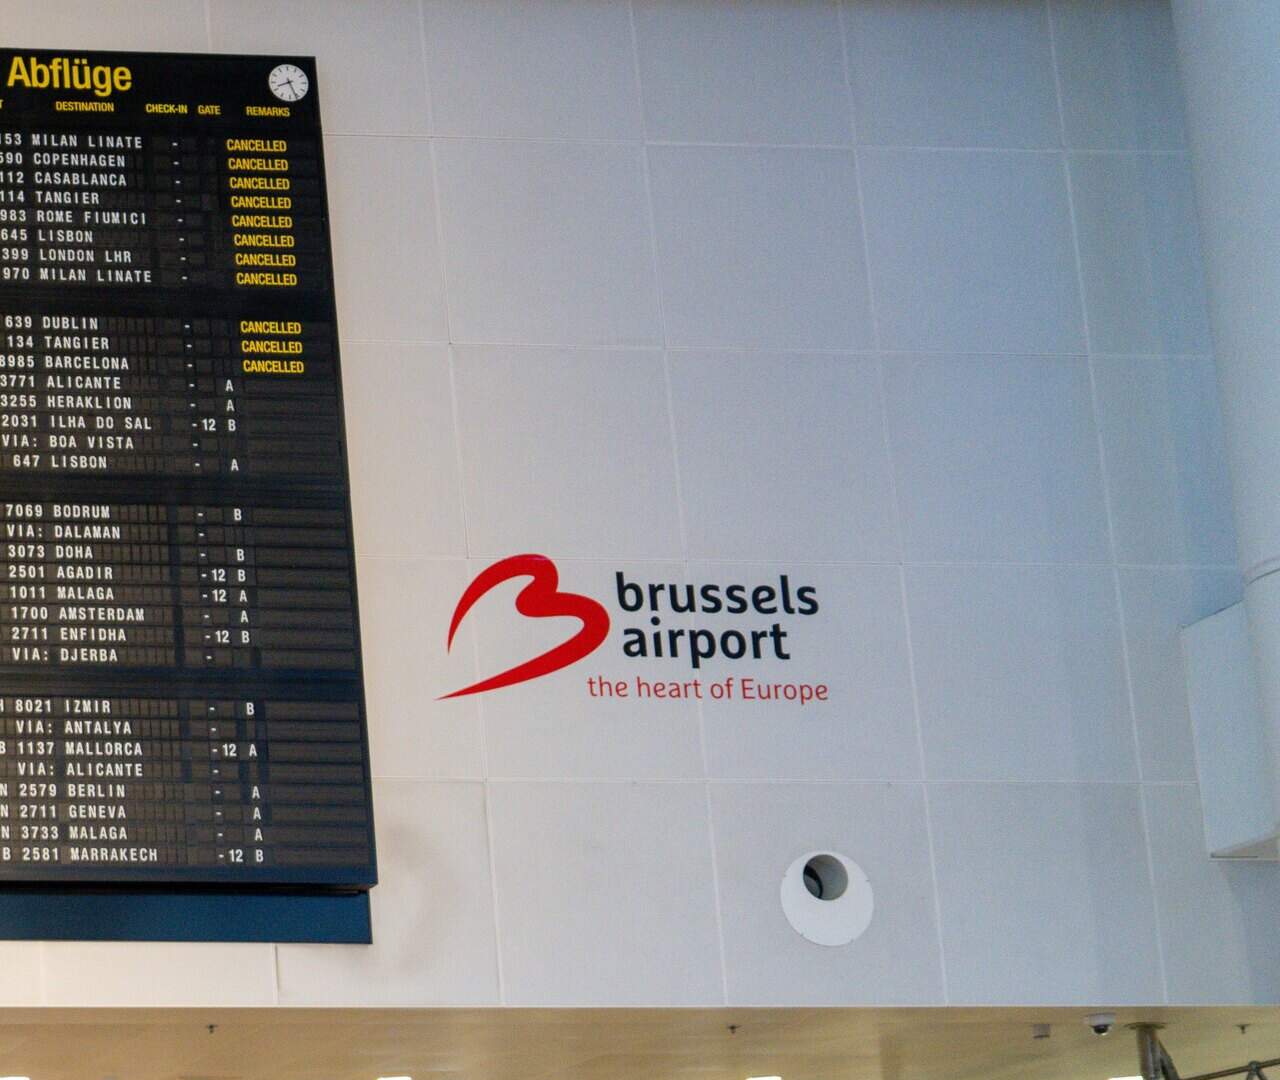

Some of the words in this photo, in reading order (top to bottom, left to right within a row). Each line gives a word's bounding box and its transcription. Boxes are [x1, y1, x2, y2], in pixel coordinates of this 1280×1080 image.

[8, 57, 131, 96] Abflüge
[56, 101, 114, 111] DESTINATION
[146, 104, 187, 113] CHECK-IN
[198, 105, 220, 114] GATE
[246, 106, 290, 116] REMARKS
[34, 153, 125, 167] COPENHAGEN
[229, 158, 288, 170] CANCELLED
[1, 229, 27, 240] 645
[39, 230, 92, 242] LISBON
[234, 234, 294, 247] CANCELLED
[45, 356, 128, 369] BARCELONA
[243, 360, 304, 373] CANCELLED
[1, 395, 36, 407] 3255
[48, 396, 131, 409] HERAKLION
[9, 565, 44, 578] 2501
[57, 566, 112, 579] AGADIR
[615, 571, 820, 616] brussels
[12, 607, 47, 619] 1700
[59, 607, 144, 621] AMSTERDAM
[622, 616, 791, 668] airport
[588, 676, 628, 698] the
[636, 677, 702, 700] heart
[710, 678, 734, 700] of
[741, 678, 829, 705] Europe
[18, 742, 54, 754] 1137
[66, 742, 142, 755] MALLORCA
[223, 744, 236, 756] 12
[22, 847, 58, 860] 2581
[70, 847, 157, 861] MARRAKECH
[229, 849, 243, 862] 12
